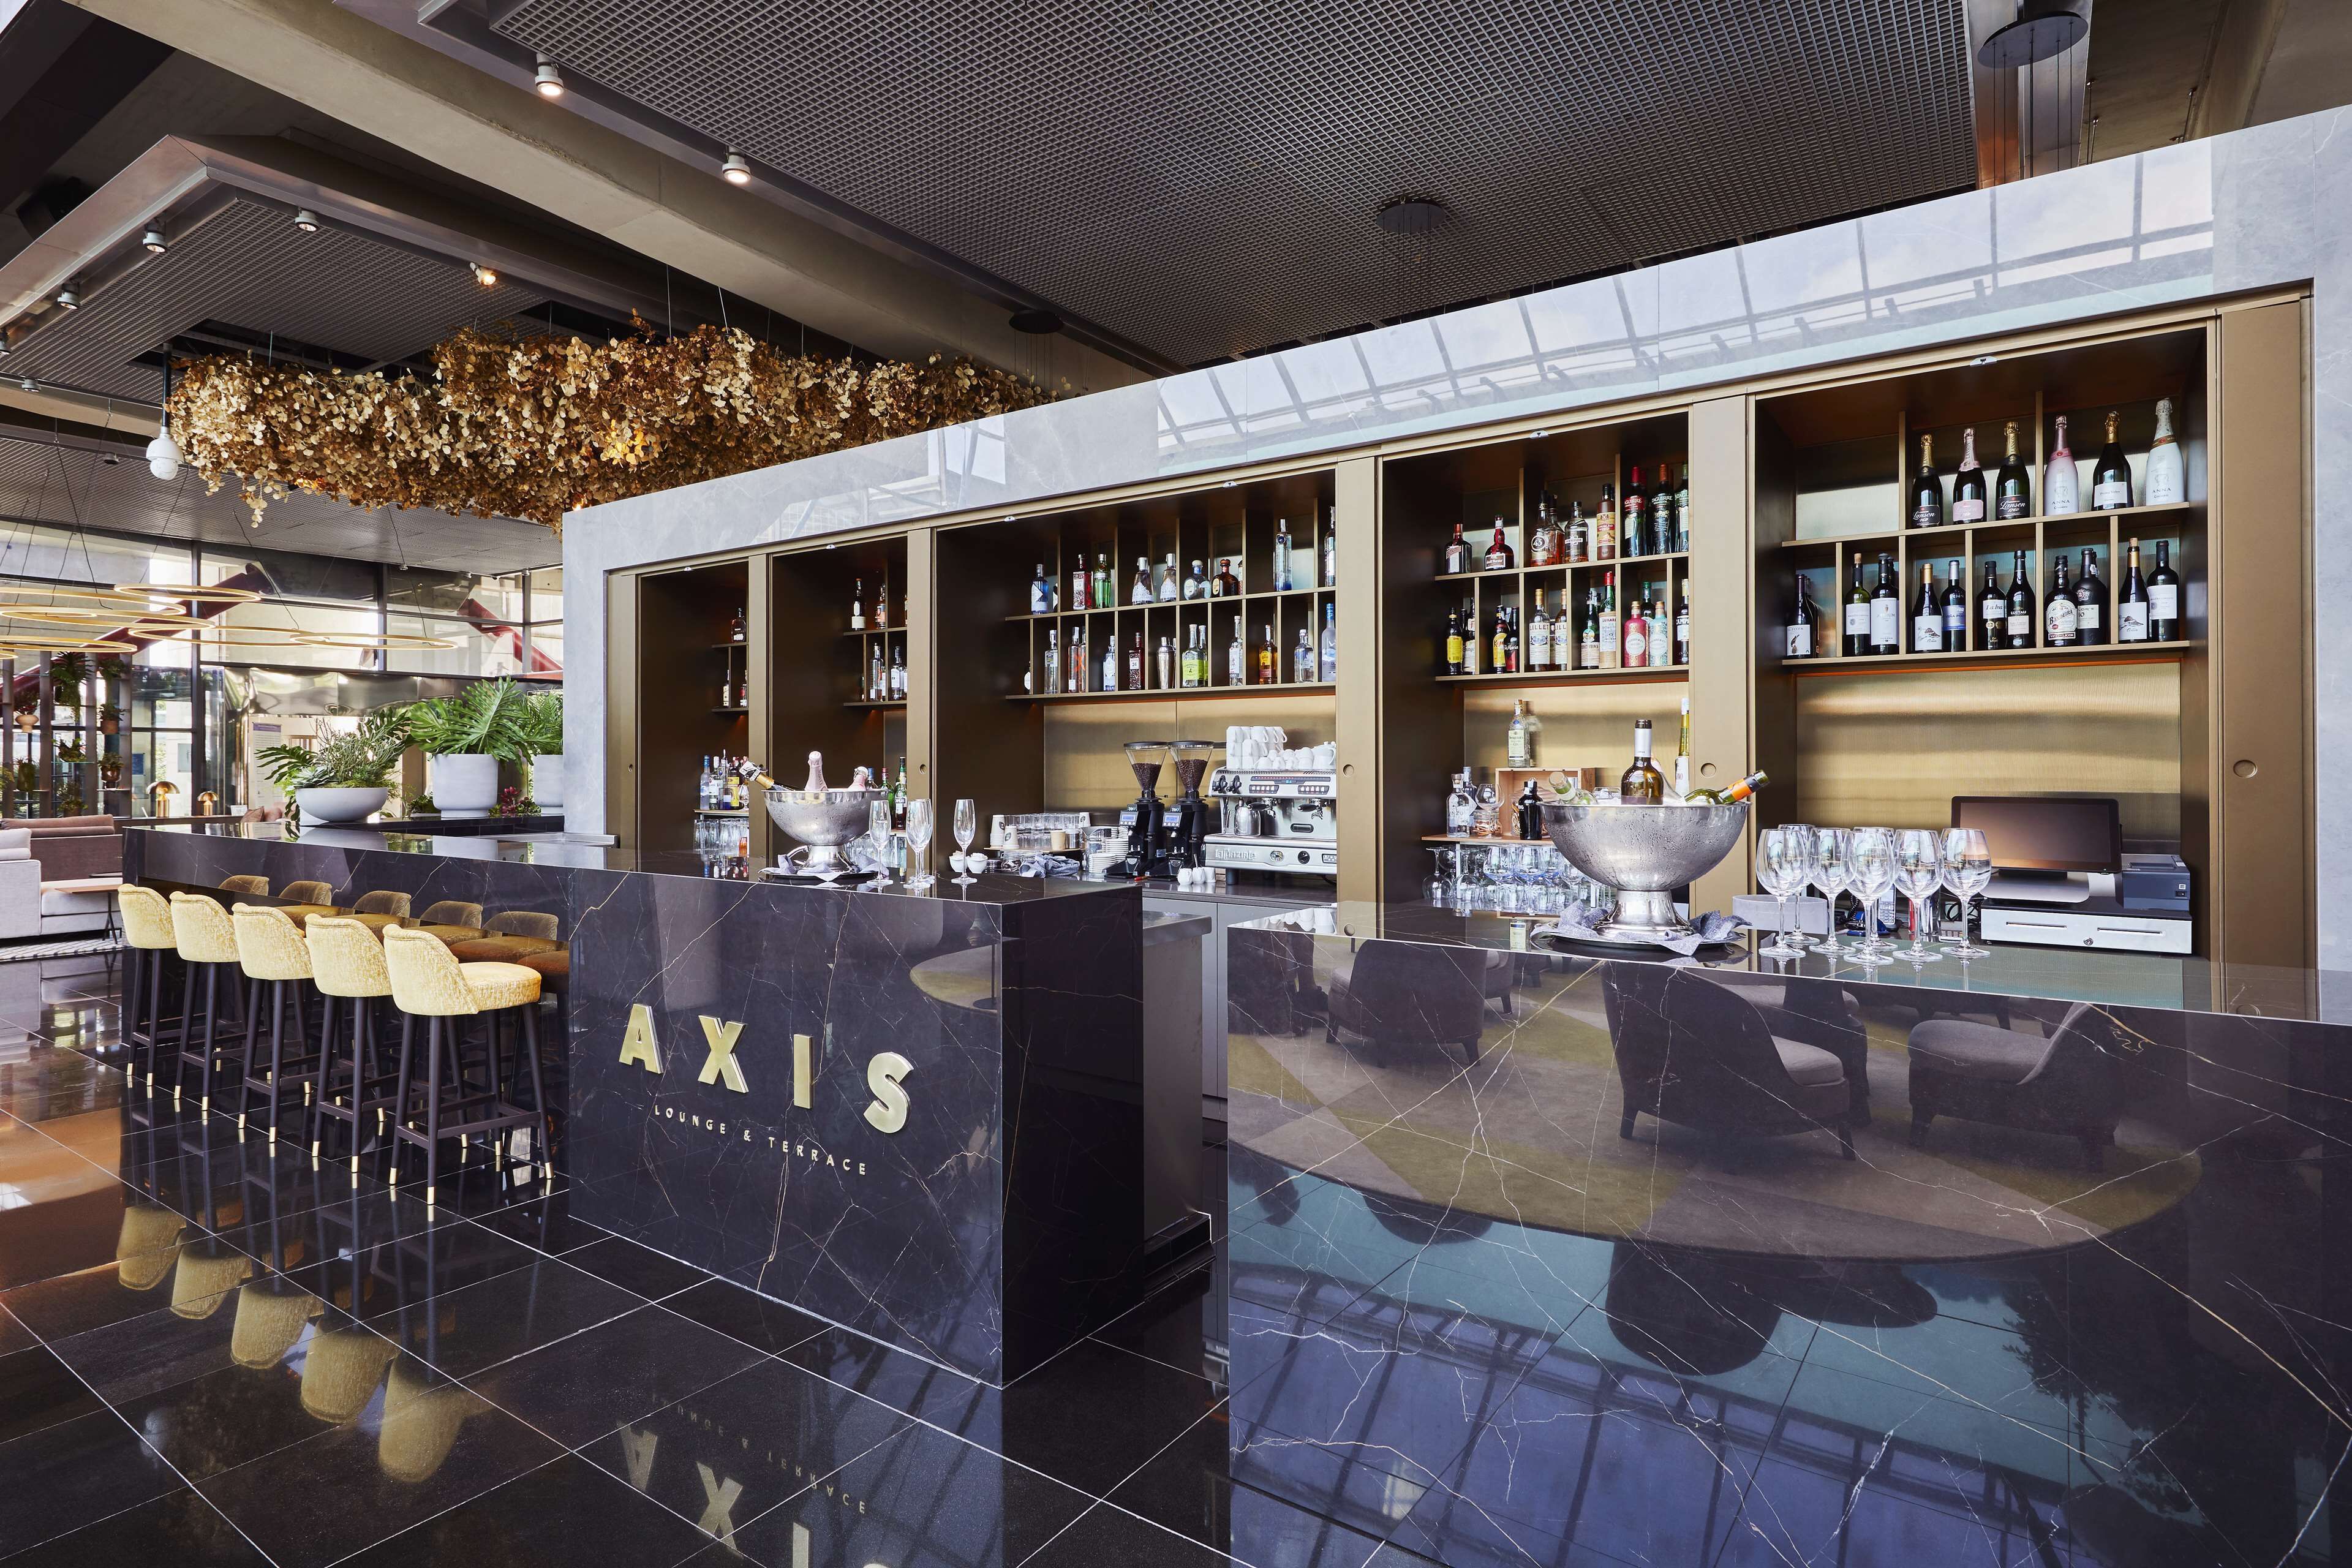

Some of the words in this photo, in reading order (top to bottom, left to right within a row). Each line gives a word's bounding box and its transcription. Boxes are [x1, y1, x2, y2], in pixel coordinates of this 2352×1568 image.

[1913, 510, 1936, 521] Lanson
[2000, 500, 2026, 510] Lanson
[619, 1003, 914, 1134] AXIS
[655, 1105, 726, 1134] LOUNGE
[744, 1129, 752, 1142] &
[769, 1137, 866, 1175] TERRACE
